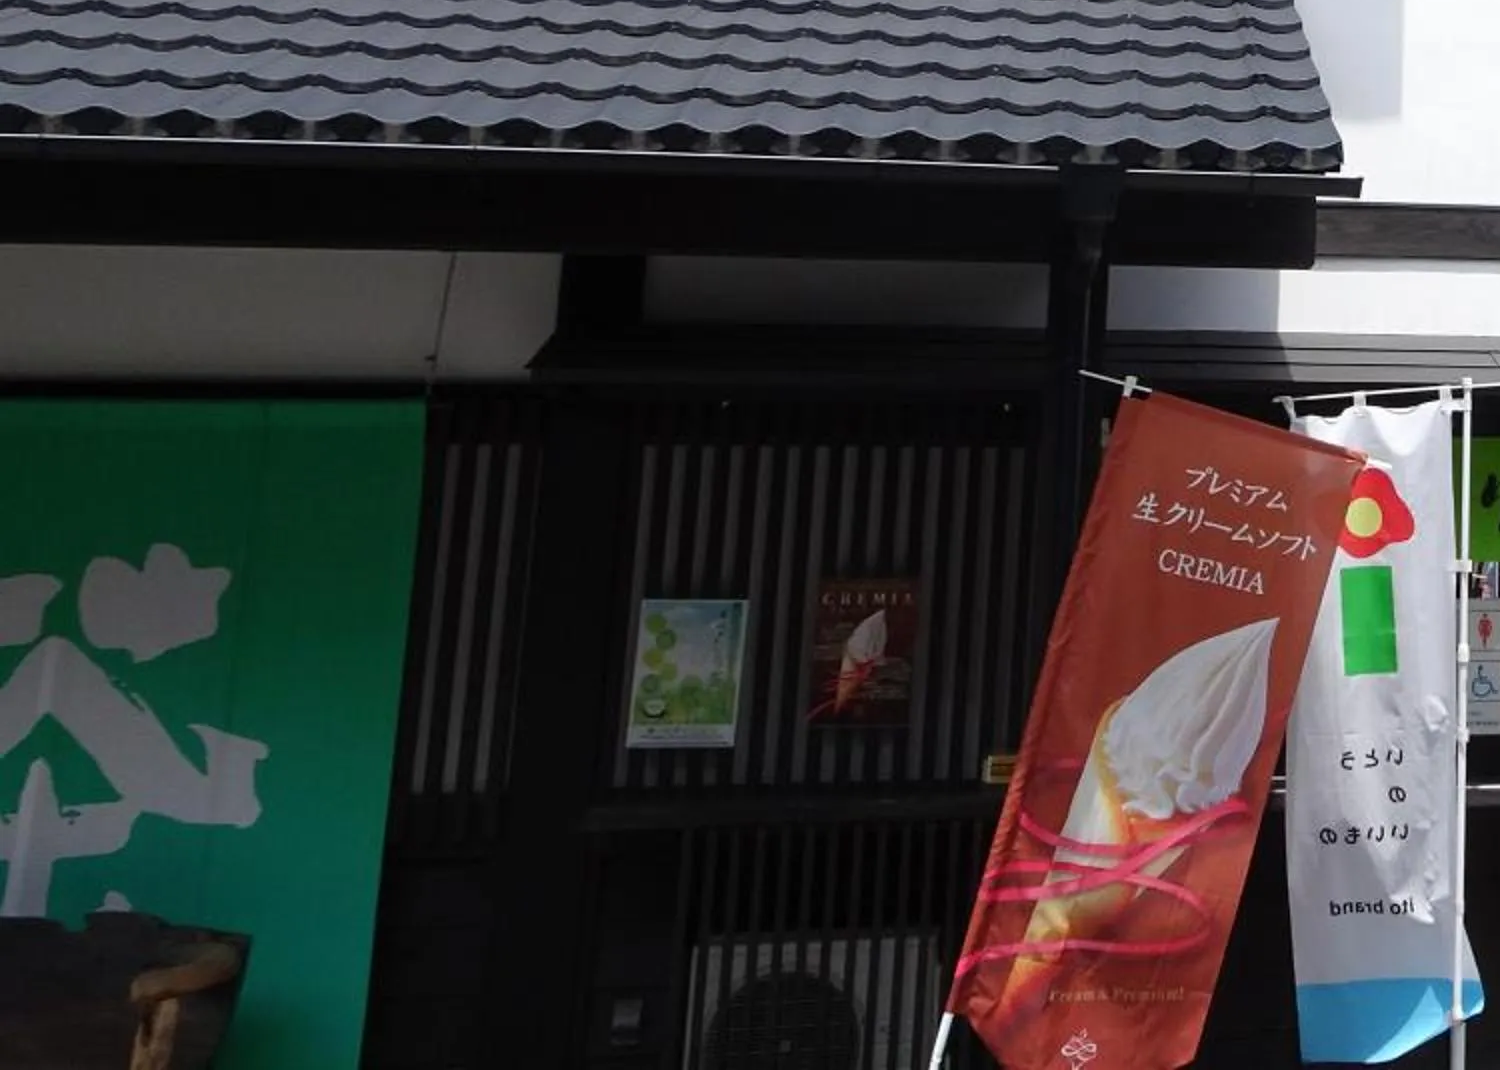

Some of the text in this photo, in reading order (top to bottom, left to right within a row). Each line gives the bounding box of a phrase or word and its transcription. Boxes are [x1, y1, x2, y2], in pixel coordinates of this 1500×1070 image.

[1184, 464, 1288, 513] プレミアム
[1131, 496, 1317, 560] 生クリームソフト
[1158, 547, 1266, 596] CREMIA
